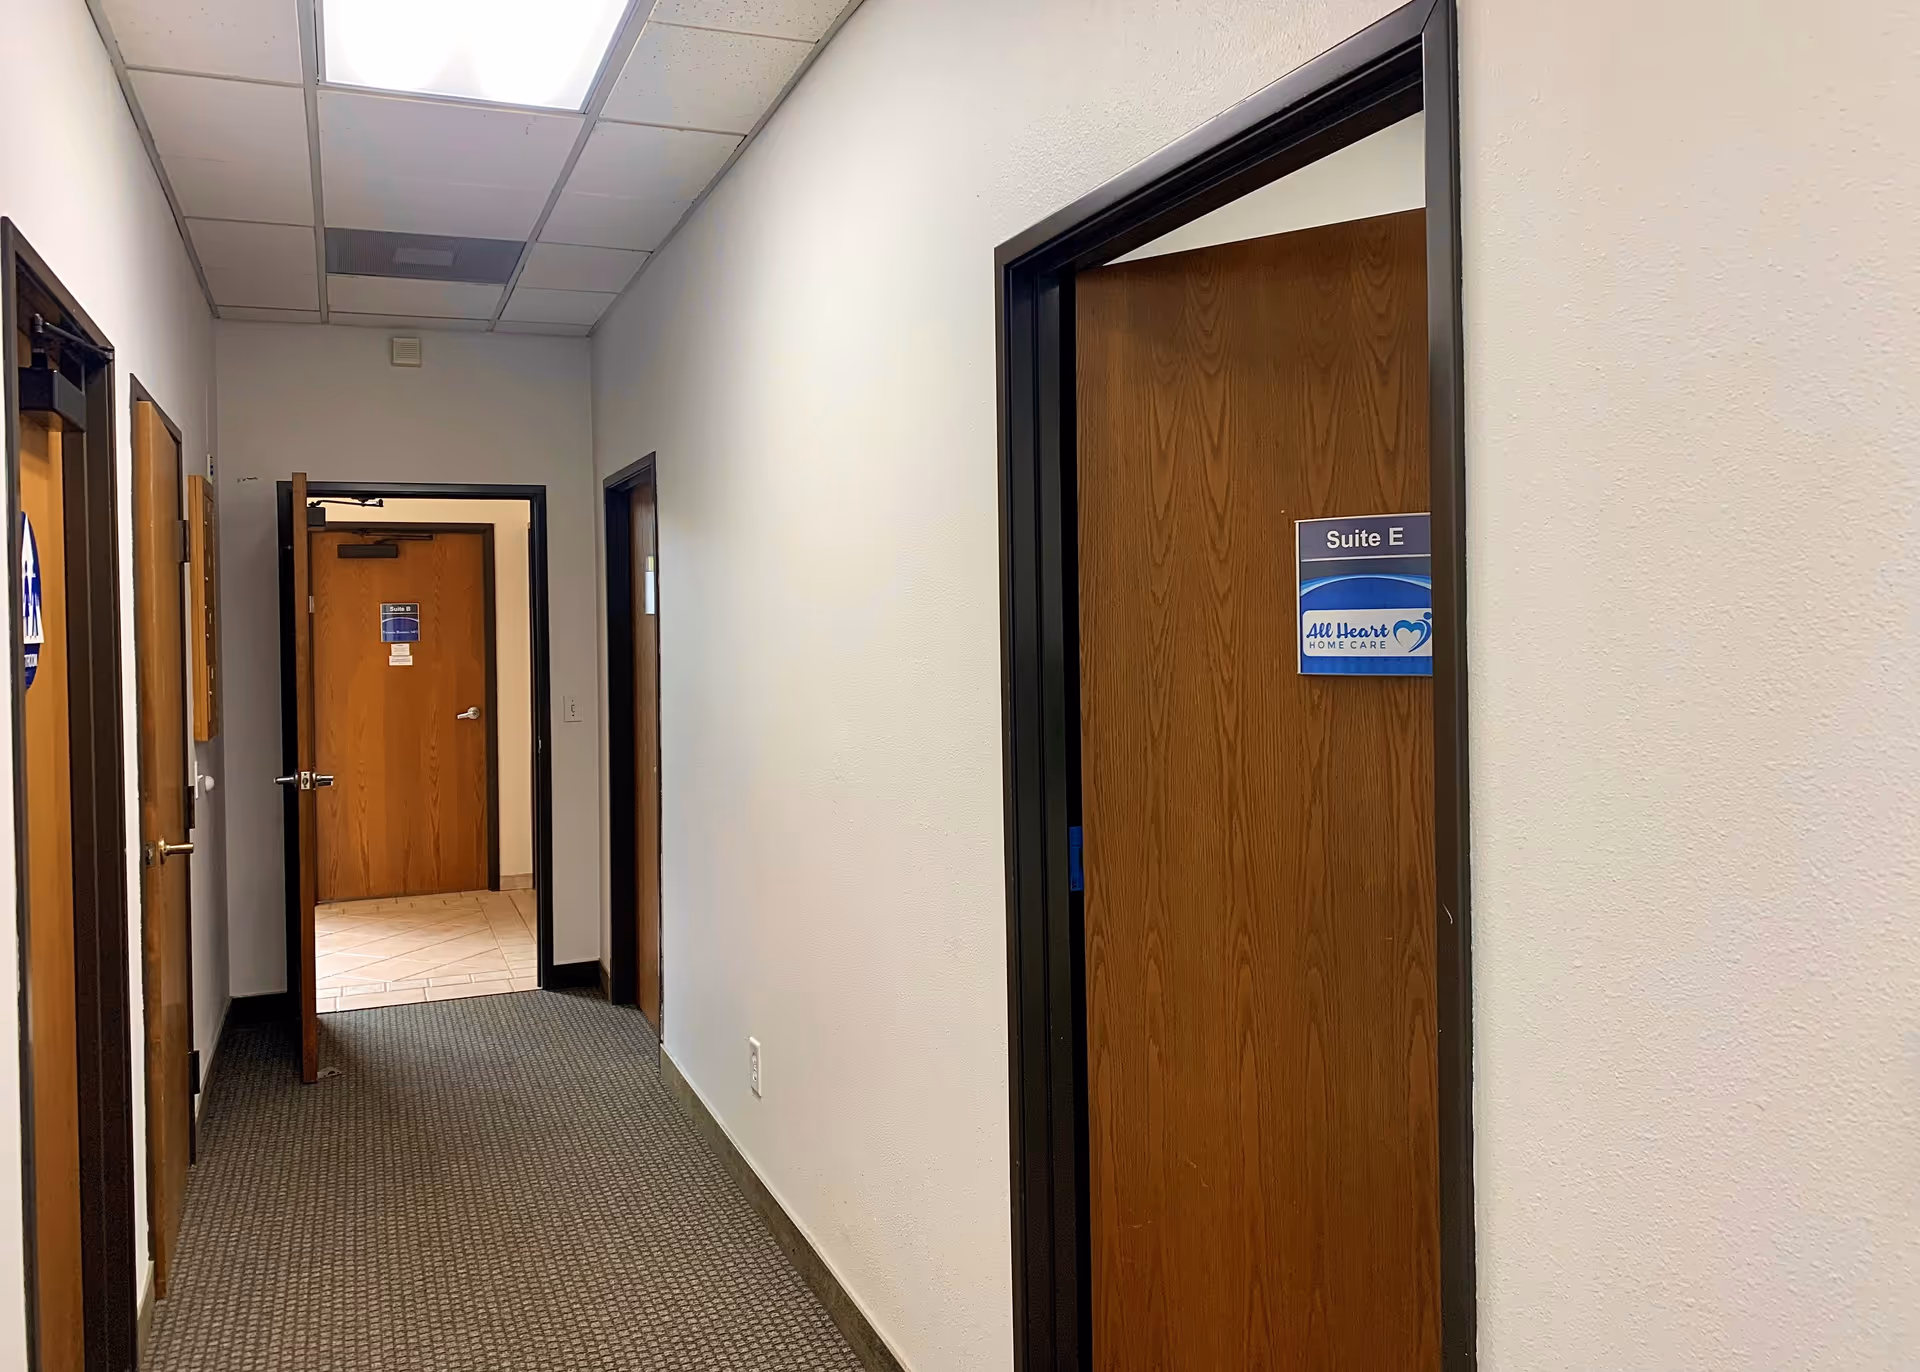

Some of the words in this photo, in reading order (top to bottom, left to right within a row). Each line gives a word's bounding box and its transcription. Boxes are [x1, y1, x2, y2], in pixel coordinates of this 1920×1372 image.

[1326, 529, 1381, 549] Suite
[1388, 527, 1404, 546] E
[1306, 622, 1333, 639] All
[1336, 622, 1390, 639] Heart
[1309, 641, 1345, 649] HOME
[1350, 641, 1386, 649] CARE
